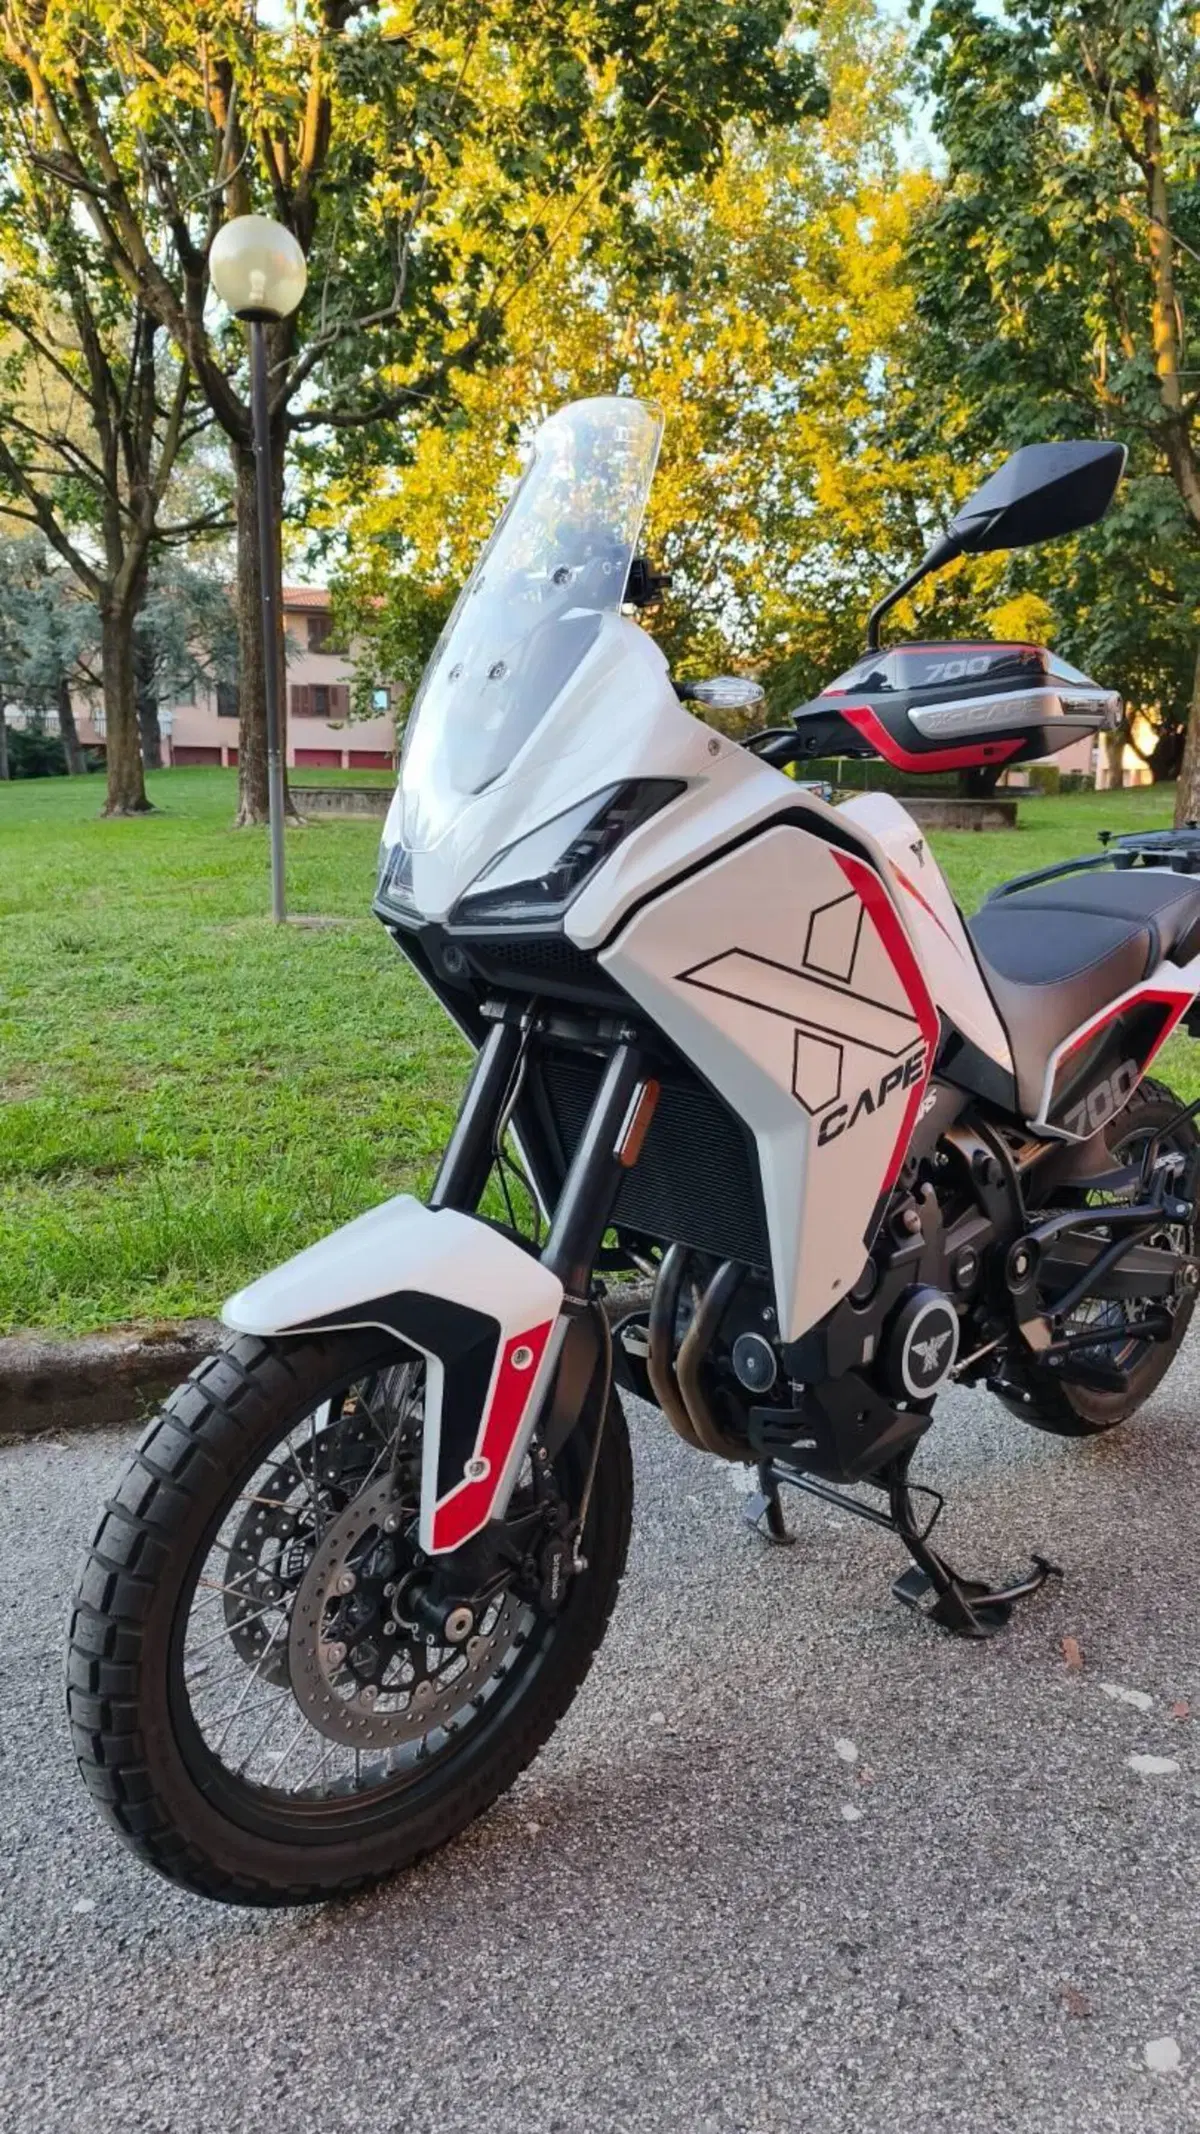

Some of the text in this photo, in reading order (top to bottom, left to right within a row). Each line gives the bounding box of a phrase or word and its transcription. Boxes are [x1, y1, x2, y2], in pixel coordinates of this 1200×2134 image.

[925, 656, 992, 682] 700
[817, 1046, 927, 1147] CAPE
[1063, 1058, 1138, 1136] 700
